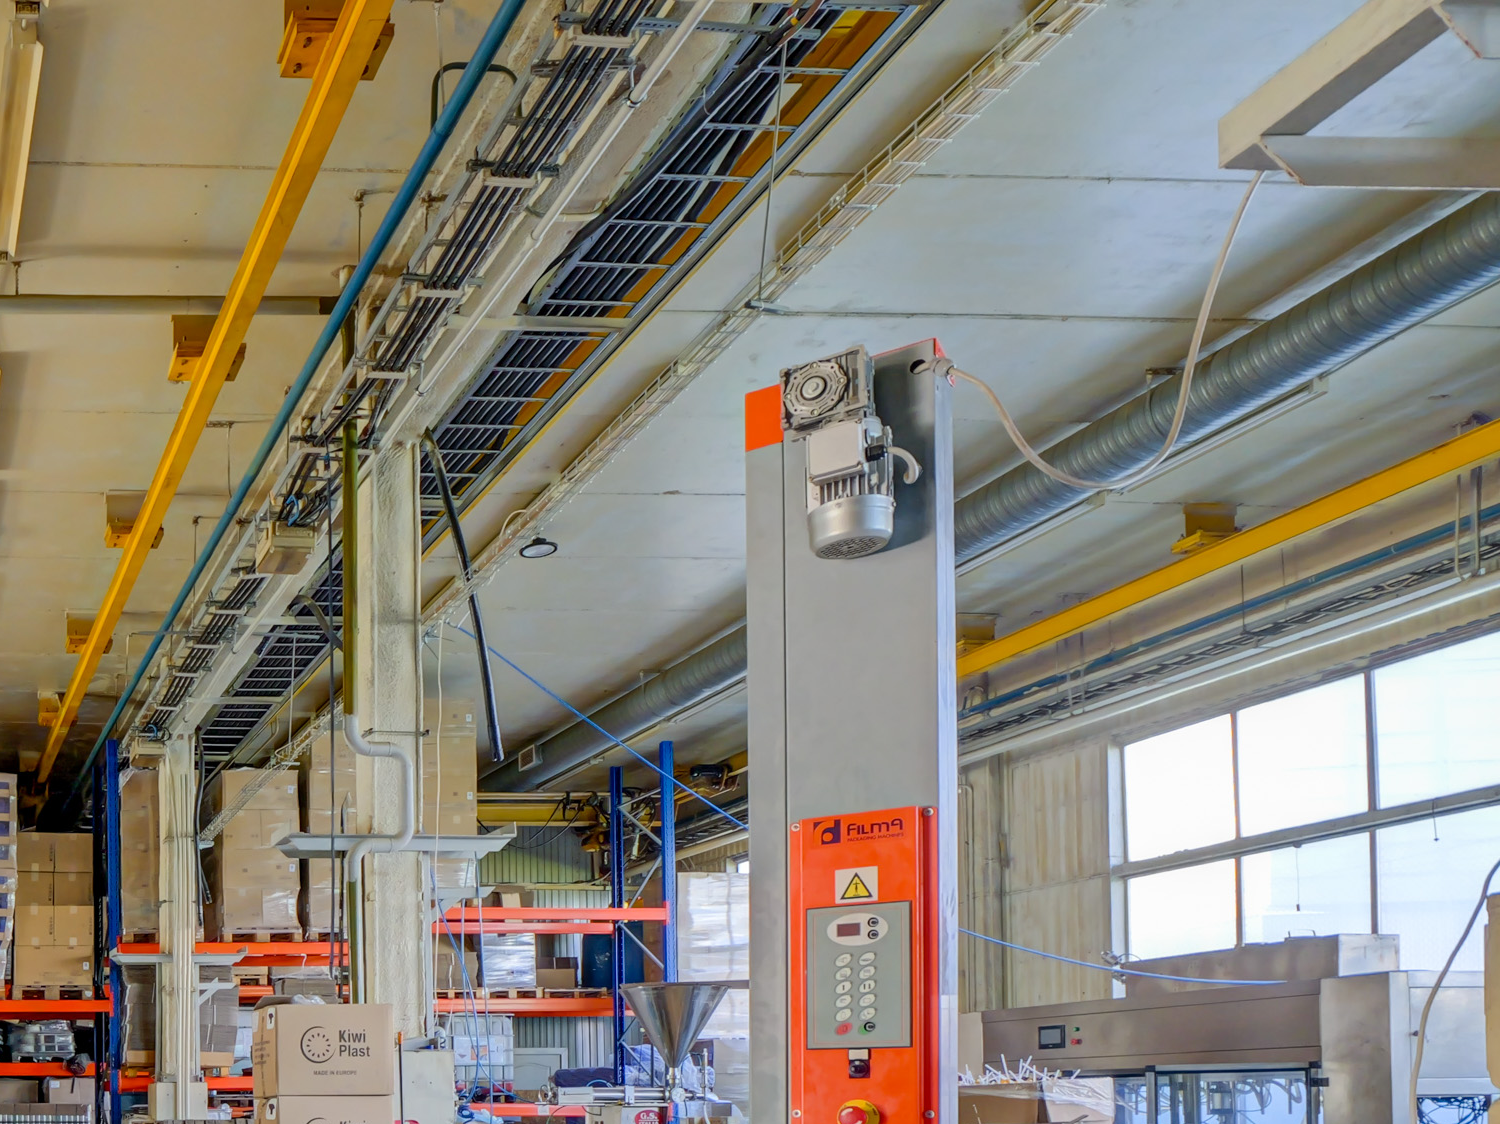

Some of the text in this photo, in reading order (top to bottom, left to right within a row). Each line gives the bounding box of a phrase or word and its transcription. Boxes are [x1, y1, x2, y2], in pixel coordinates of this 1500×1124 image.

[847, 818, 903, 836] FILMA
[338, 1029, 366, 1043] Kiwi
[339, 1044, 371, 1057] Plast
[640, 1112, 658, 1120] G.S.
